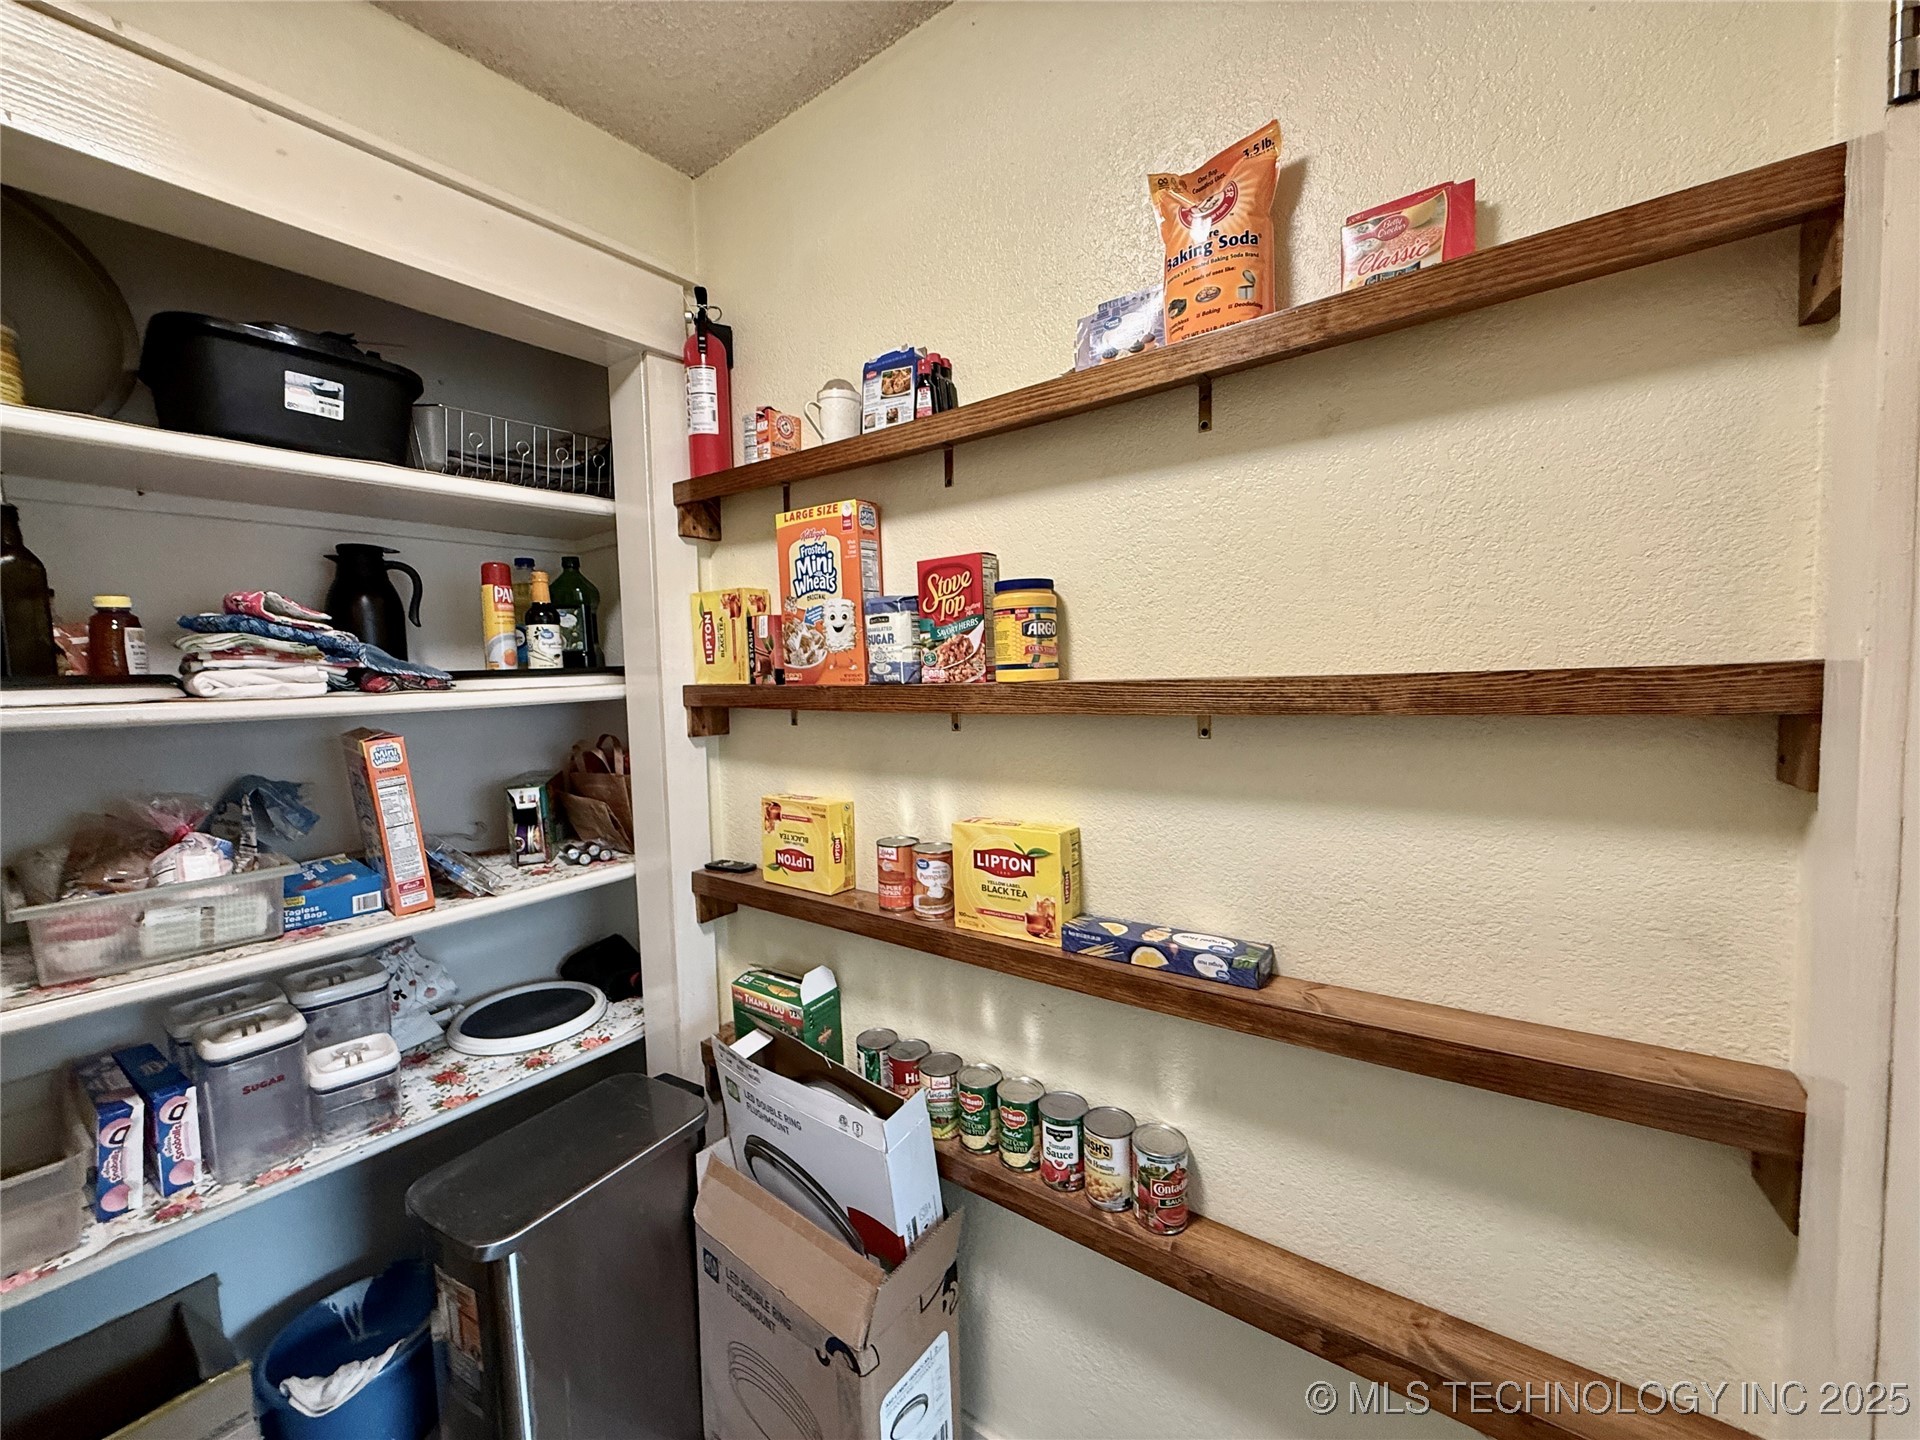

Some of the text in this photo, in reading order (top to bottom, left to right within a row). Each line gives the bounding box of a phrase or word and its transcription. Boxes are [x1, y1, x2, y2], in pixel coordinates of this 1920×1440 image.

[1262, 137, 1275, 149] lb.
[1377, 223, 1406, 238] Crocker
[1383, 218, 1403, 229] Betty
[1219, 230, 1259, 249] Soda
[1211, 255, 1229, 264] Baking
[1358, 239, 1429, 275] Classic
[784, 504, 838, 522] LARGE SIZE
[800, 528, 827, 541] Kellogg's
[800, 543, 826, 558] Frosted
[796, 552, 833, 579] Mini
[794, 570, 836, 596] Wheats
[806, 594, 826, 602] ORIGINAL
[923, 571, 972, 613] Stove
[939, 595, 965, 622] Top
[937, 618, 979, 637] SAVORY HERBS
[1027, 622, 1056, 635] ARGO
[704, 614, 713, 662] LIPTON
[867, 633, 895, 645] SUGAR
[374, 749, 397, 759] Mini
[790, 835, 809, 843] BLACK
[777, 853, 812, 869] LIPTON
[976, 853, 1031, 873] LIPTON
[920, 872, 948, 881] Pumpkin
[981, 884, 1028, 898] BLACK TEA
[284, 905, 319, 917] Tagless
[304, 911, 327, 920] Bags
[744, 994, 768, 1010] THANK
[769, 1002, 785, 1015] YOU
[242, 1074, 285, 1095] SUGAR
[744, 1090, 802, 1131] LED DOUBLE RING
[745, 1101, 790, 1135] FLUSHMOUNT
[1013, 1138, 1028, 1147] CORN
[1048, 1142, 1070, 1150] Tomato
[1046, 1147, 1073, 1159] Sauce
[725, 1267, 792, 1331] LED DOUBLE RING
[726, 1282, 777, 1334] FLUSHMOUNT
